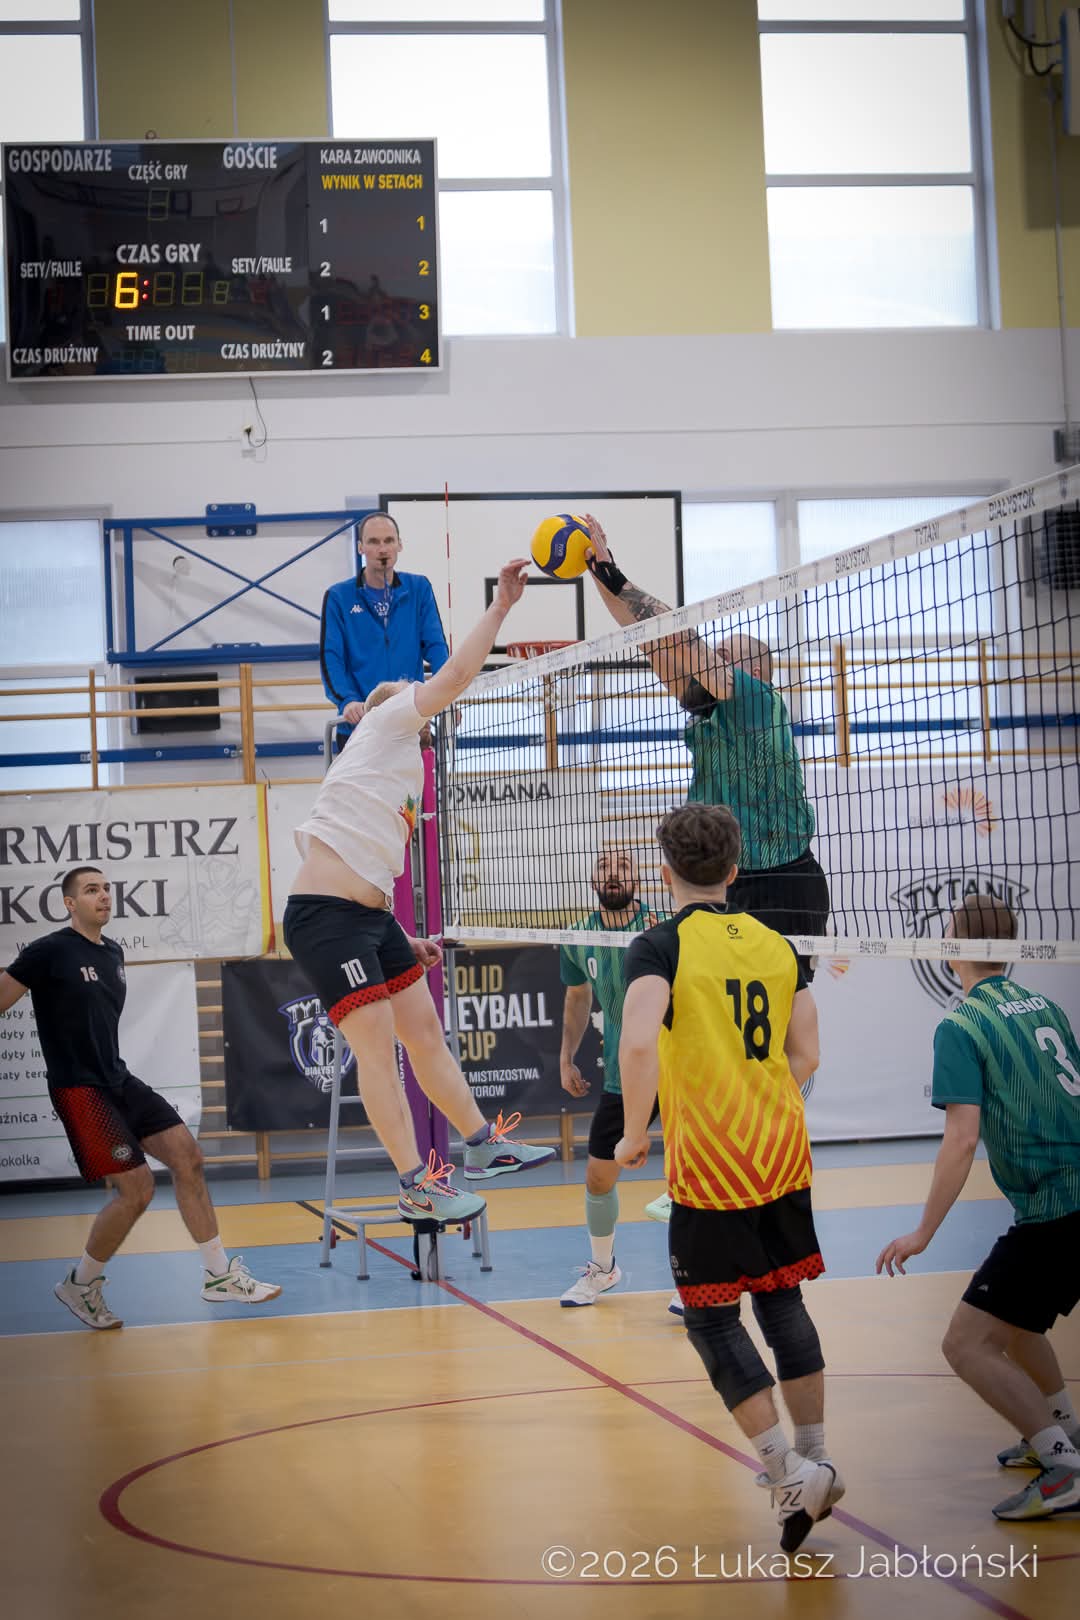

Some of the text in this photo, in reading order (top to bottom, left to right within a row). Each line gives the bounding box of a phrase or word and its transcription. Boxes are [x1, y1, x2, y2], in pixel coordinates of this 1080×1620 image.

[9, 149, 112, 173] GOSPODARZE
[223, 142, 277, 169] GOŚCIE
[320, 149, 421, 165] KARA ZAWODNIKA
[128, 160, 188, 183] CZĘŚĆ GRY
[321, 174, 423, 190] WYNIK W SETACH
[319, 218, 328, 234] 1
[416, 215, 426, 231] 1
[116, 243, 201, 264] CZAS GRY
[20, 260, 82, 279] SETY/FAULE
[231, 255, 292, 275] SETY/FAULE
[320, 261, 331, 277] 2
[418, 260, 429, 276] 2
[321, 305, 331, 321] 1
[419, 304, 430, 320] 3
[126, 325, 196, 341] TIME OUT
[13, 343, 99, 364] CZAS DRUŻYNY
[221, 338, 304, 360] CZAS DRUŻYNY
[420, 348, 432, 364] 4
[322, 350, 333, 366] 2
[0, 871, 169, 925] KÓKI
[80, 966, 99, 982] 16
[341, 958, 368, 988] 10
[726, 979, 771, 1062] 18
[1035, 1026, 1080, 1096] 3
[469, 1068, 540, 1083] MISTRZOSTWA
